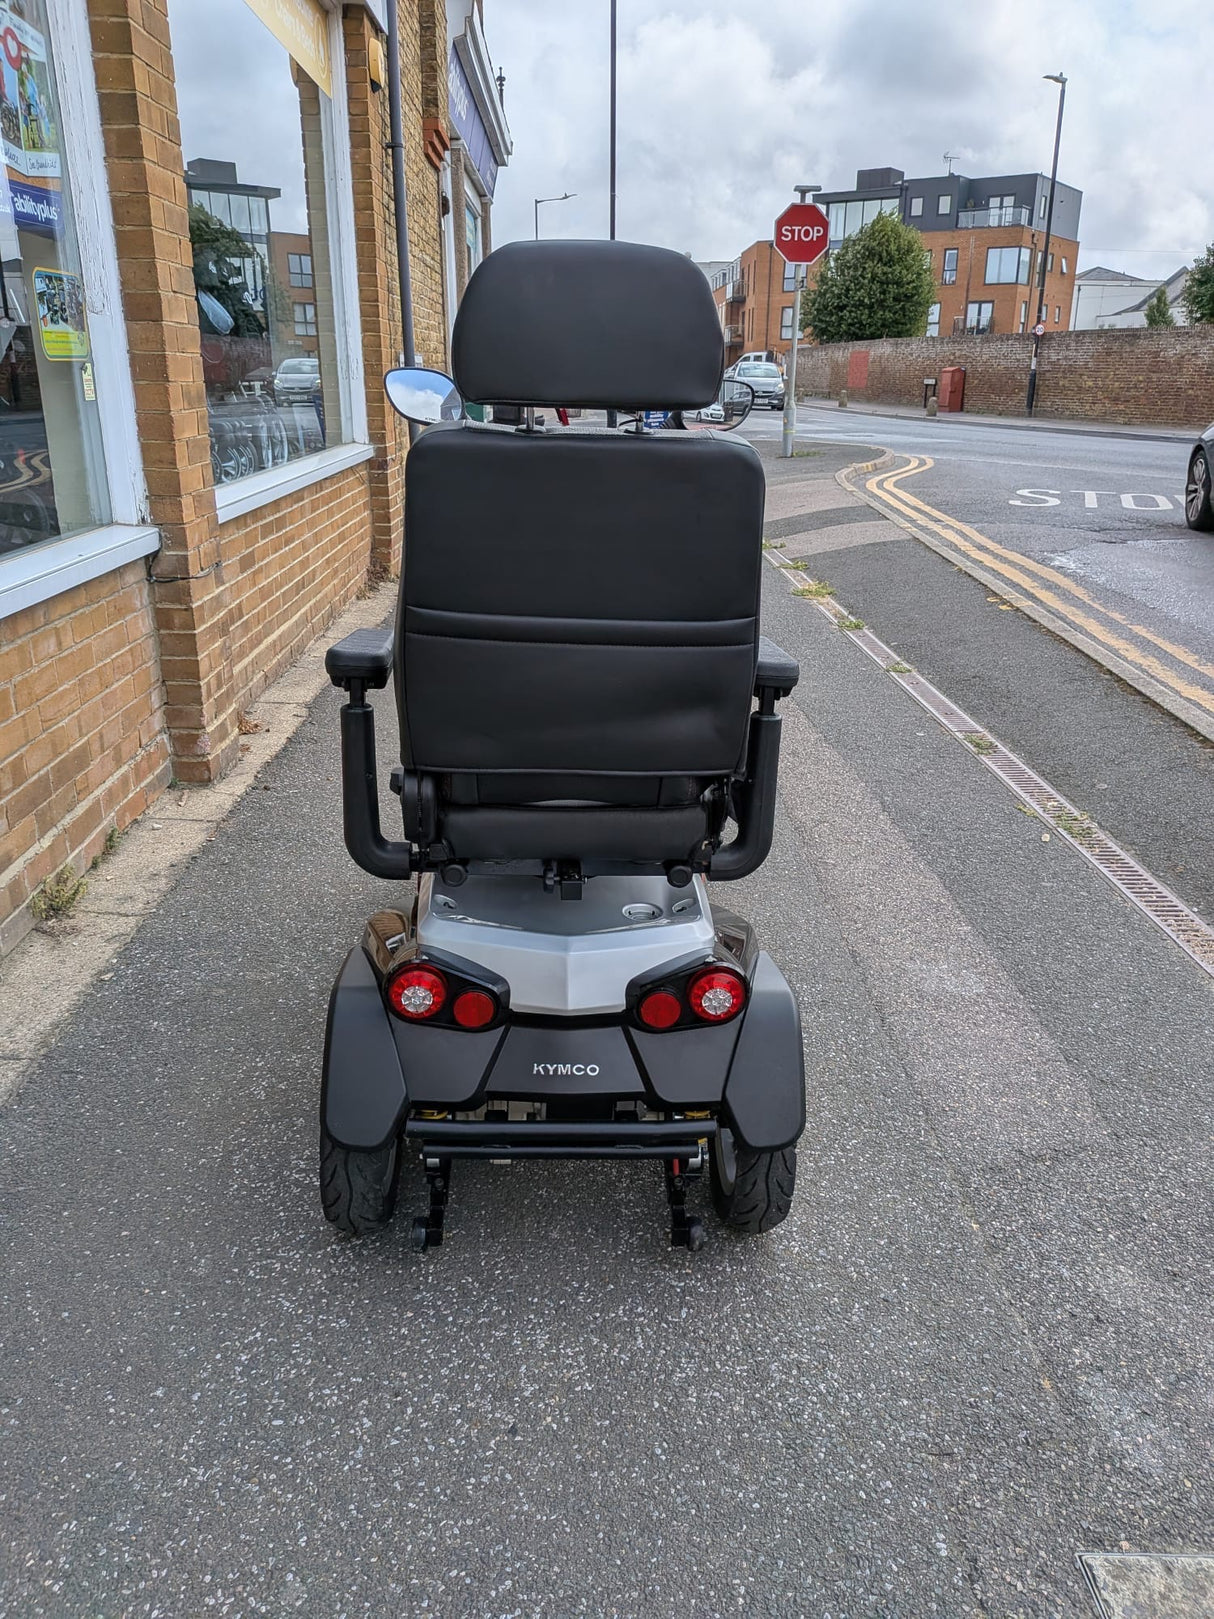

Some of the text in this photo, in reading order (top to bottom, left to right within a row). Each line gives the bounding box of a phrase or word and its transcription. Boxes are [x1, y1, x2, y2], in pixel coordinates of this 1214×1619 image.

[14, 192, 58, 222] abilityplus
[781, 226, 823, 241] STOP
[1008, 489, 1186, 511] STO
[532, 1063, 600, 1076] KYMCO
